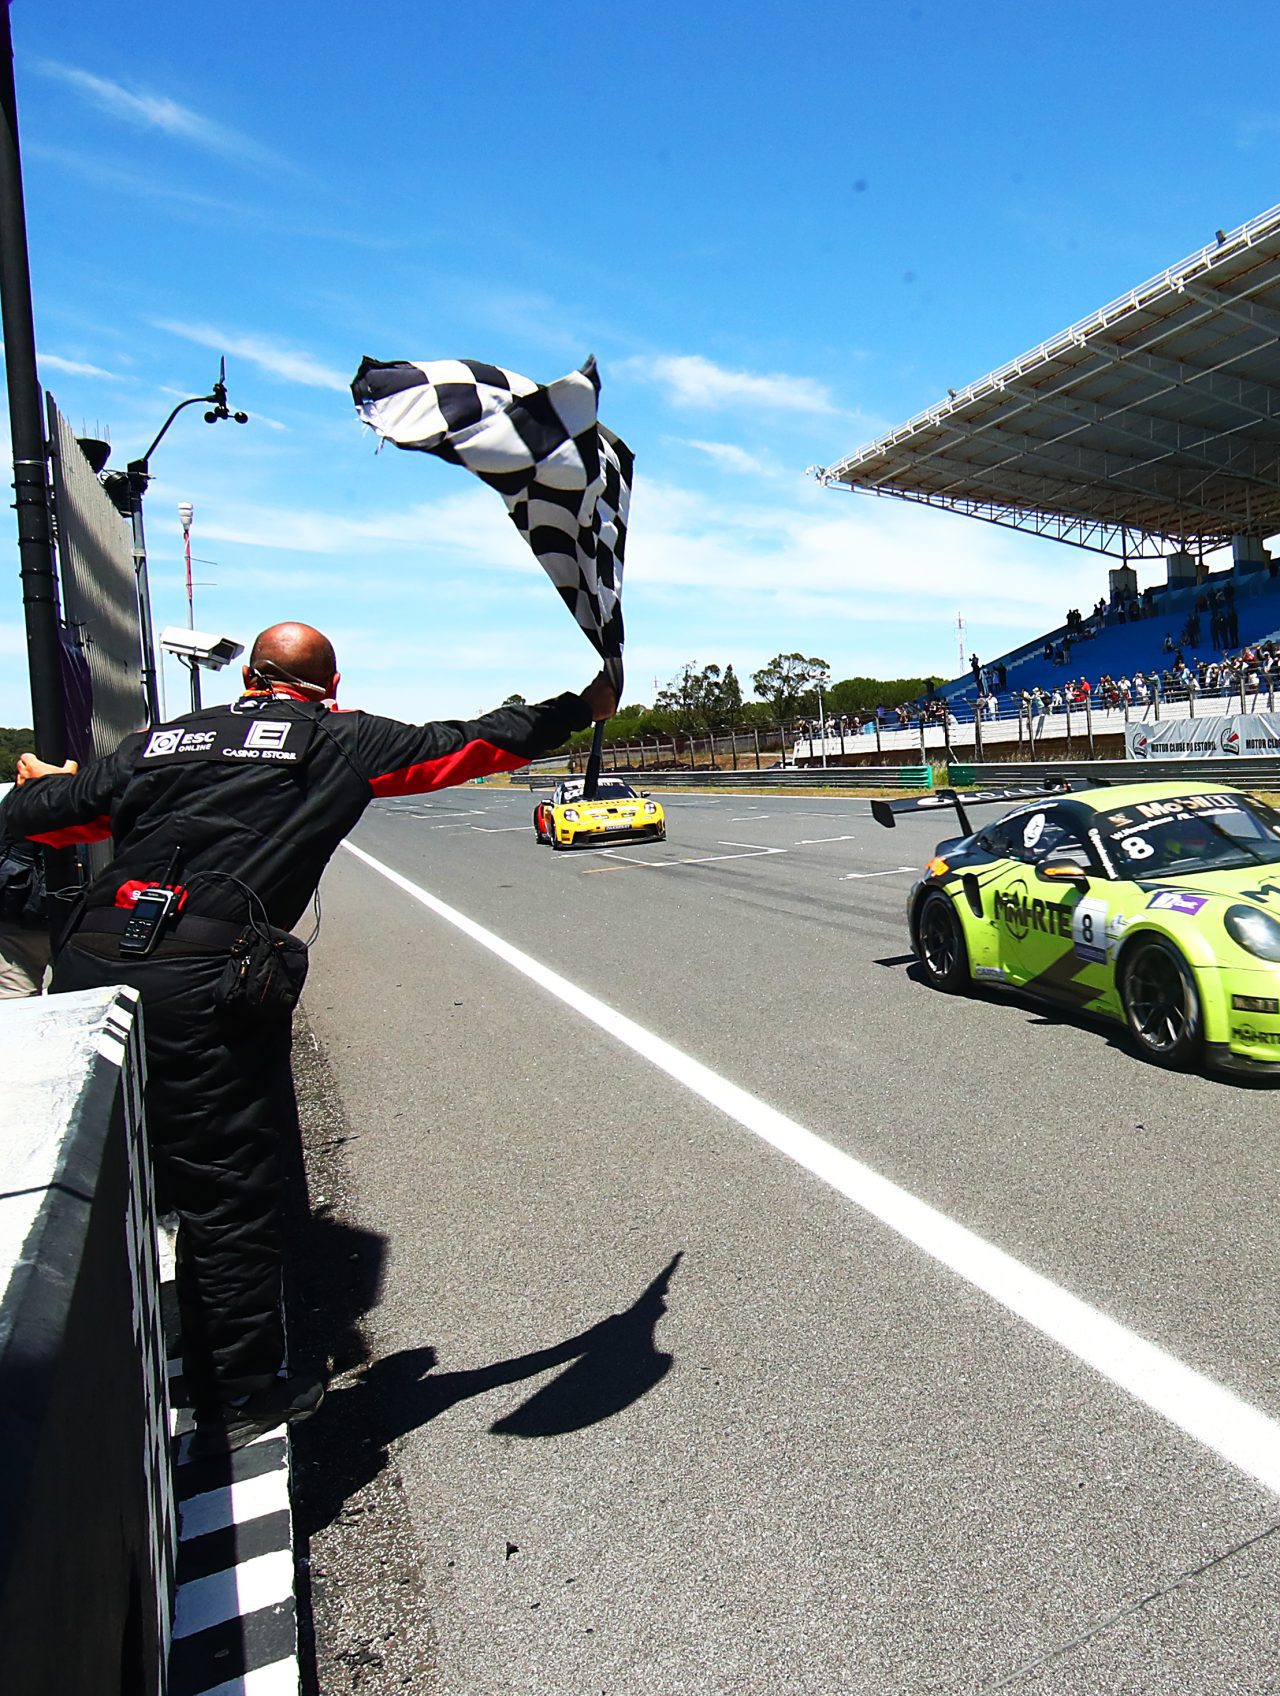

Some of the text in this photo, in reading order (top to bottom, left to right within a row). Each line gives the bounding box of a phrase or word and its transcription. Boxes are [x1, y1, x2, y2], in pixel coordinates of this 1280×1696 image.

[182, 731, 217, 744] ESC
[1246, 738, 1266, 749] MOTOR
[178, 743, 212, 753] ONLINE
[223, 748, 260, 758] CASINO
[1121, 836, 1155, 860] 8
[1082, 913, 1094, 943] 8
